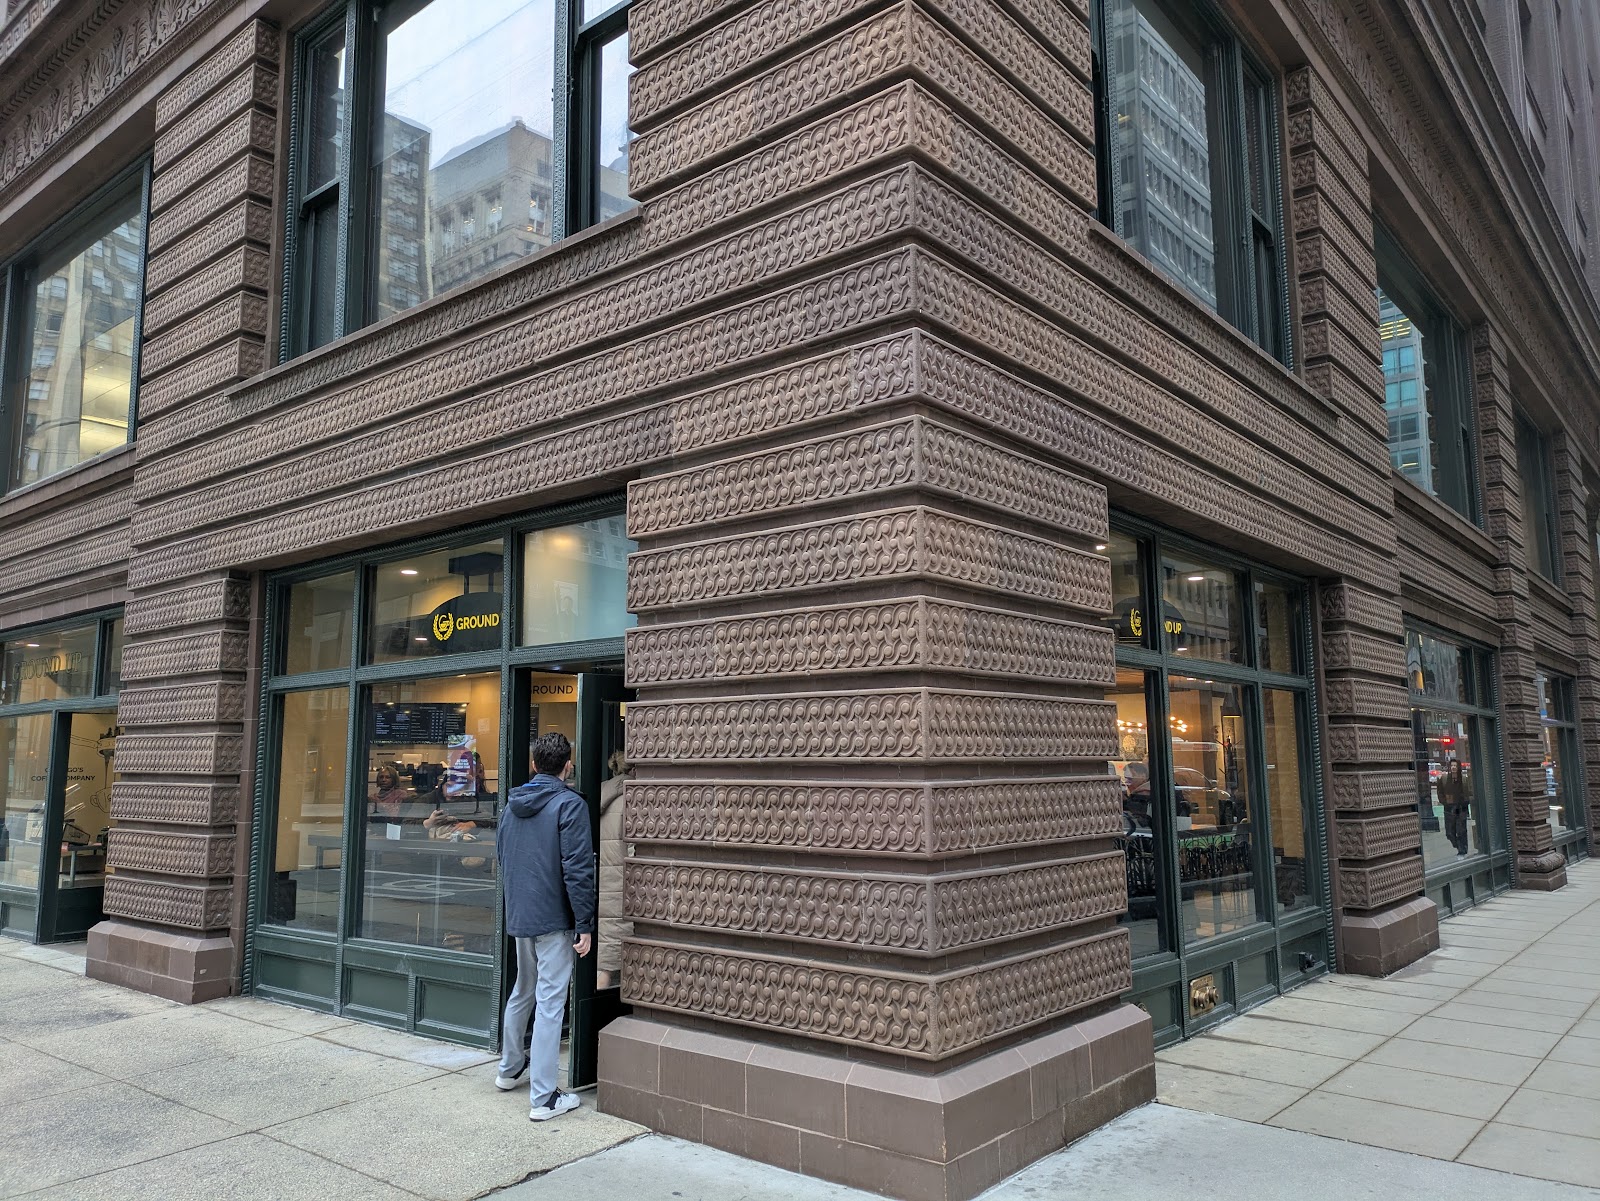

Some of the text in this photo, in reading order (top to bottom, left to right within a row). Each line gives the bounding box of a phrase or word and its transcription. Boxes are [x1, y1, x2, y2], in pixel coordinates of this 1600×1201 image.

[456, 613, 500, 631] GROUND
[1173, 621, 1182, 635] UP
[12, 652, 82, 681] GROUND UP
[531, 685, 574, 695] ROUND
